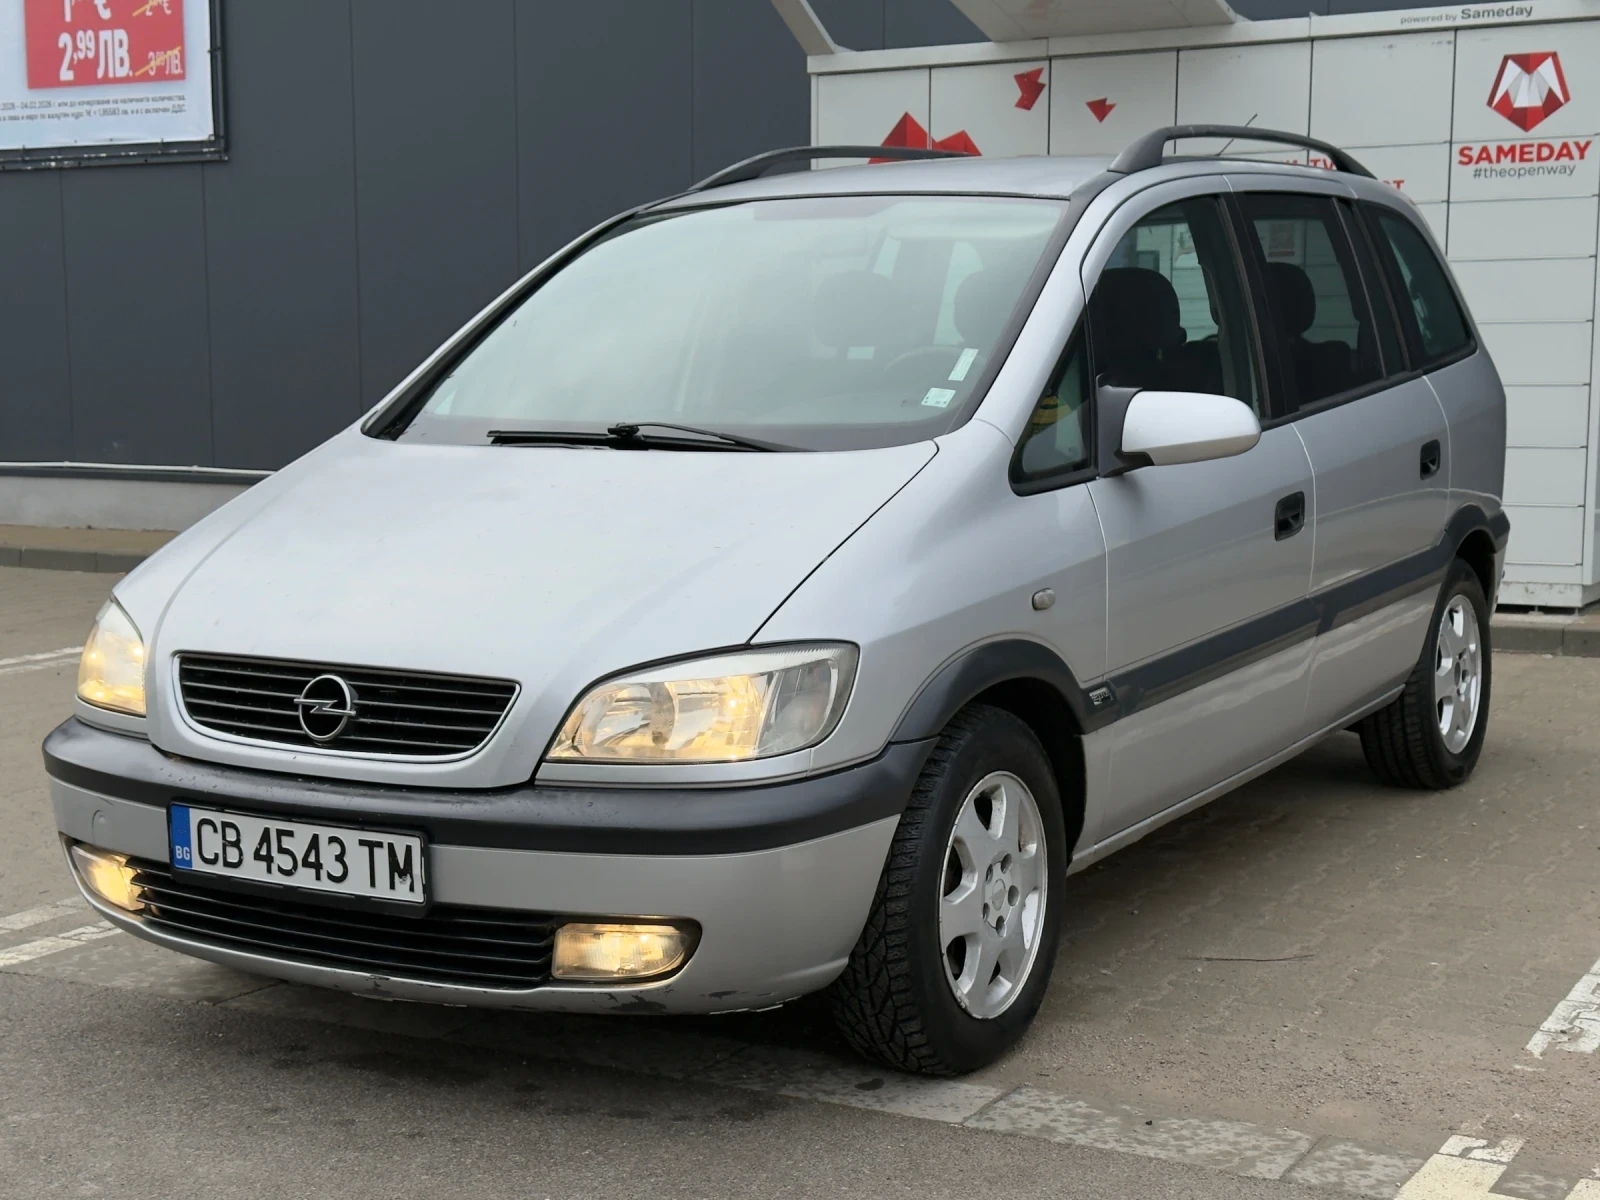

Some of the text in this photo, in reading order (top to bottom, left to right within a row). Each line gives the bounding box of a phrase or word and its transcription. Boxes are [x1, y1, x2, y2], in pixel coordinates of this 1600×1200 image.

[1400, 5, 1533, 25] powered by Sameday
[58, 29, 95, 82] 2,99
[1458, 139, 1593, 166] SAMEDAY
[1472, 164, 1577, 179] #theopenway
[175, 846, 191, 860] BG
[196, 817, 416, 893] CB 4543 TM
